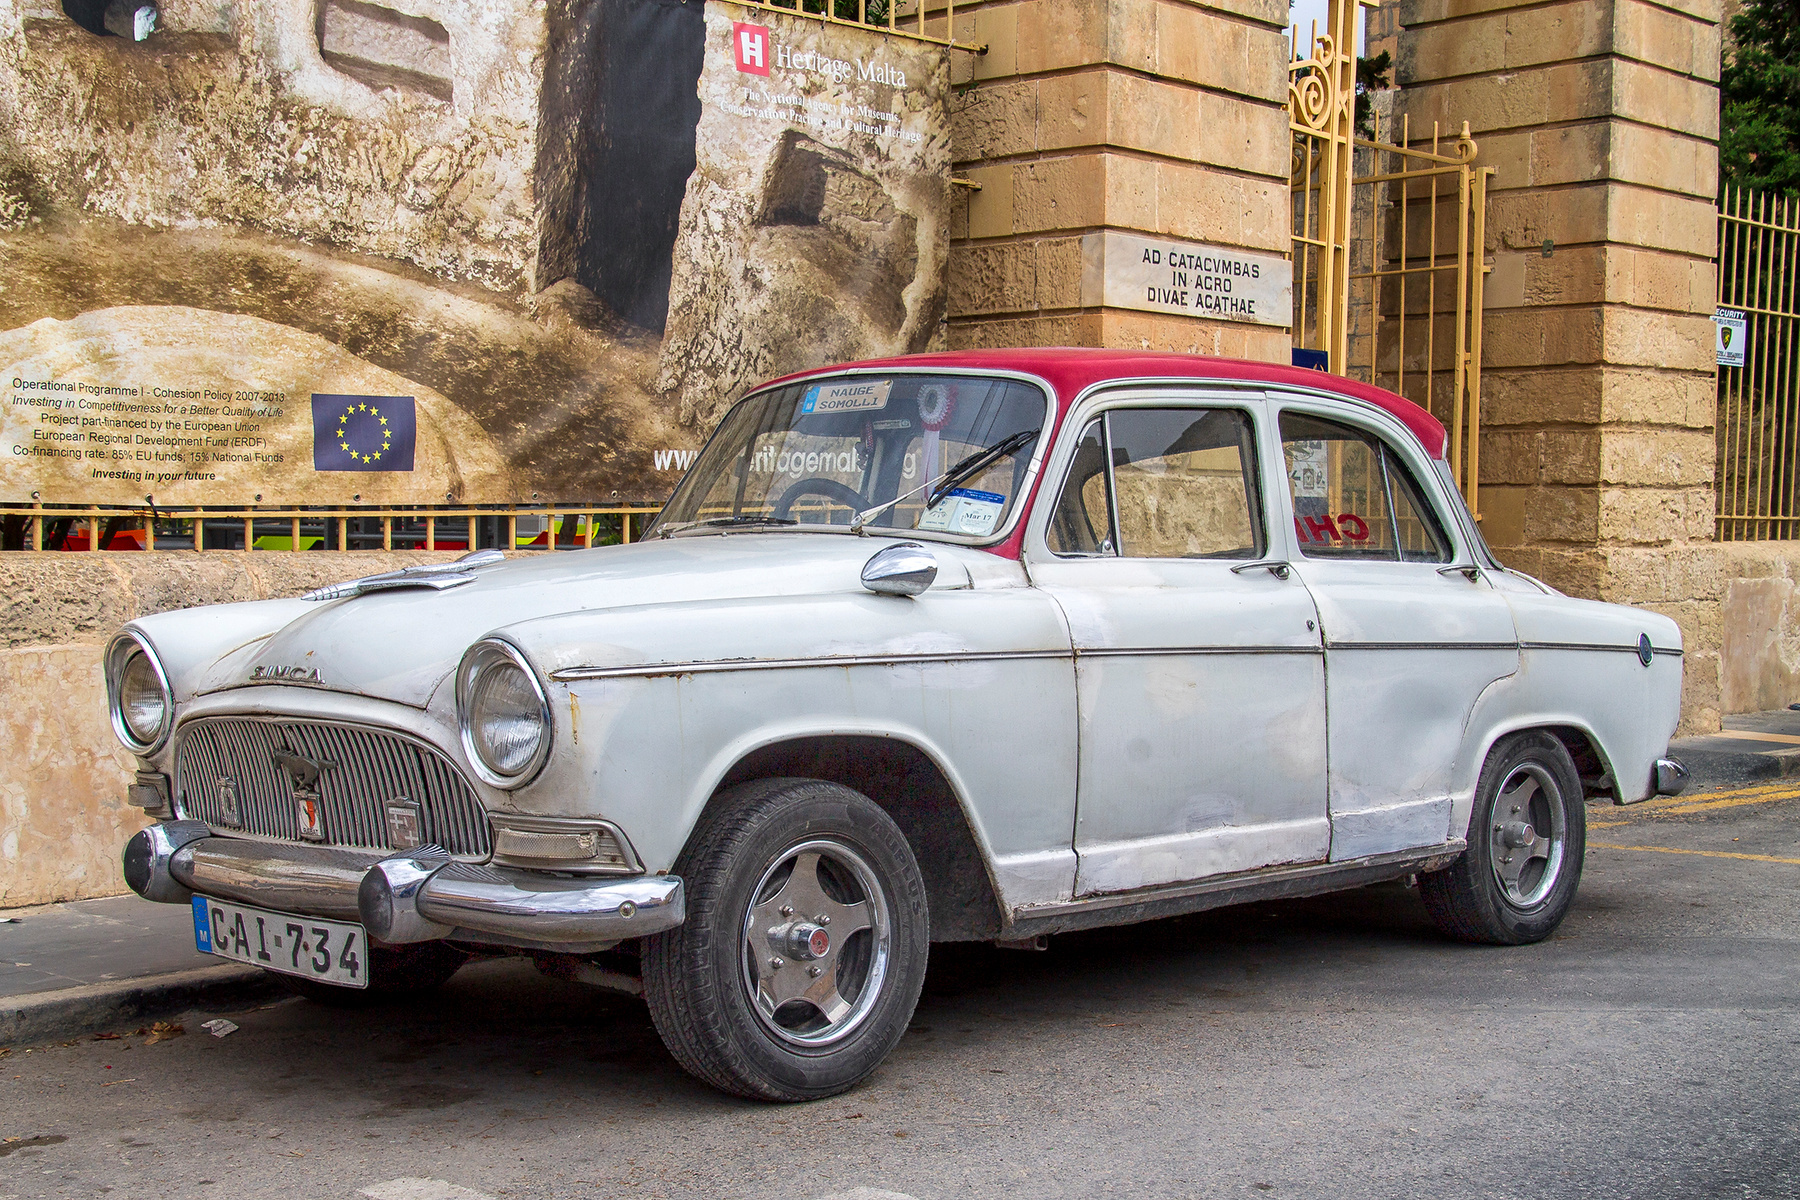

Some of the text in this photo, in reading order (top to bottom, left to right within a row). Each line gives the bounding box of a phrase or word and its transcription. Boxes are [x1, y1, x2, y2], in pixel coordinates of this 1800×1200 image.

[740, 31, 764, 68] H
[776, 44, 908, 87] Heritage Malta
[742, 87, 901, 123] The National Agency for Museums,
[720, 99, 922, 143] Conservation Practice and Cultural Heritage
[1142, 248, 1260, 279] AD CATACVMBAS
[1172, 270, 1232, 293] IN AGRO
[1147, 286, 1256, 314] DIVAE AGATHAE
[1715, 308, 1746, 319] ECURITY
[12, 377, 76, 391] Operational
[78, 382, 138, 396] Programme
[153, 387, 201, 399] Cohesion
[204, 389, 232, 402] Policy
[235, 390, 285, 402] 2007-2013
[830, 385, 875, 398] NAUGE
[12, 395, 283, 419] Investing in Competitiveness for a Better Quality of Life
[819, 397, 878, 410] SOMOLLI
[41, 413, 260, 432] Project part-financed by the European Union
[33, 429, 267, 448] European Regional Development Fund (ERDF)
[12, 445, 284, 463] Co-financing rate: 85% EU funds; 15% National Funds
[92, 468, 216, 483] Investing in your future
[965, 512, 981, 520] Mar
[253, 665, 324, 683] SIMCA
[199, 929, 208, 943] M
